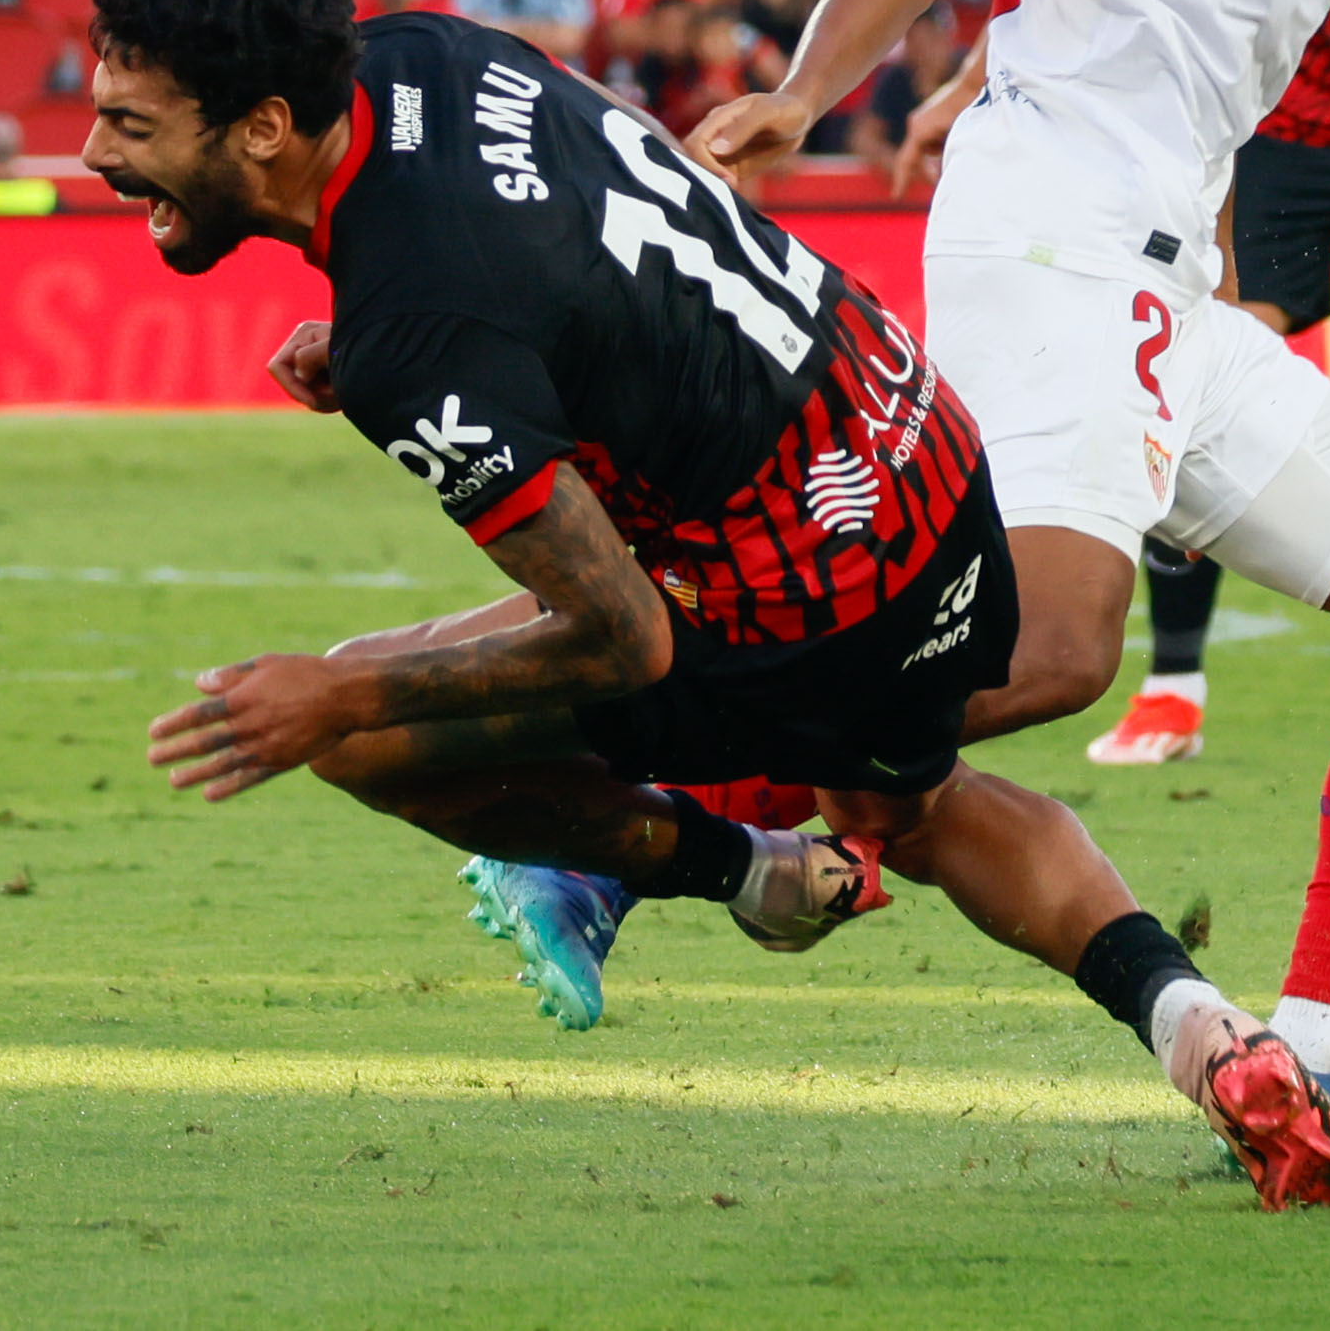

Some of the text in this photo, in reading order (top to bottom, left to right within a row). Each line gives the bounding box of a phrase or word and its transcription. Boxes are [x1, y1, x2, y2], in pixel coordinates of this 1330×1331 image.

[391, 83, 417, 151] JUANEDA
[475, 61, 550, 201] SAMU
[601, 108, 826, 375] 12
[386, 394, 493, 488] OK
[890, 415, 922, 472] HOTELS
[911, 406, 928, 422] &
